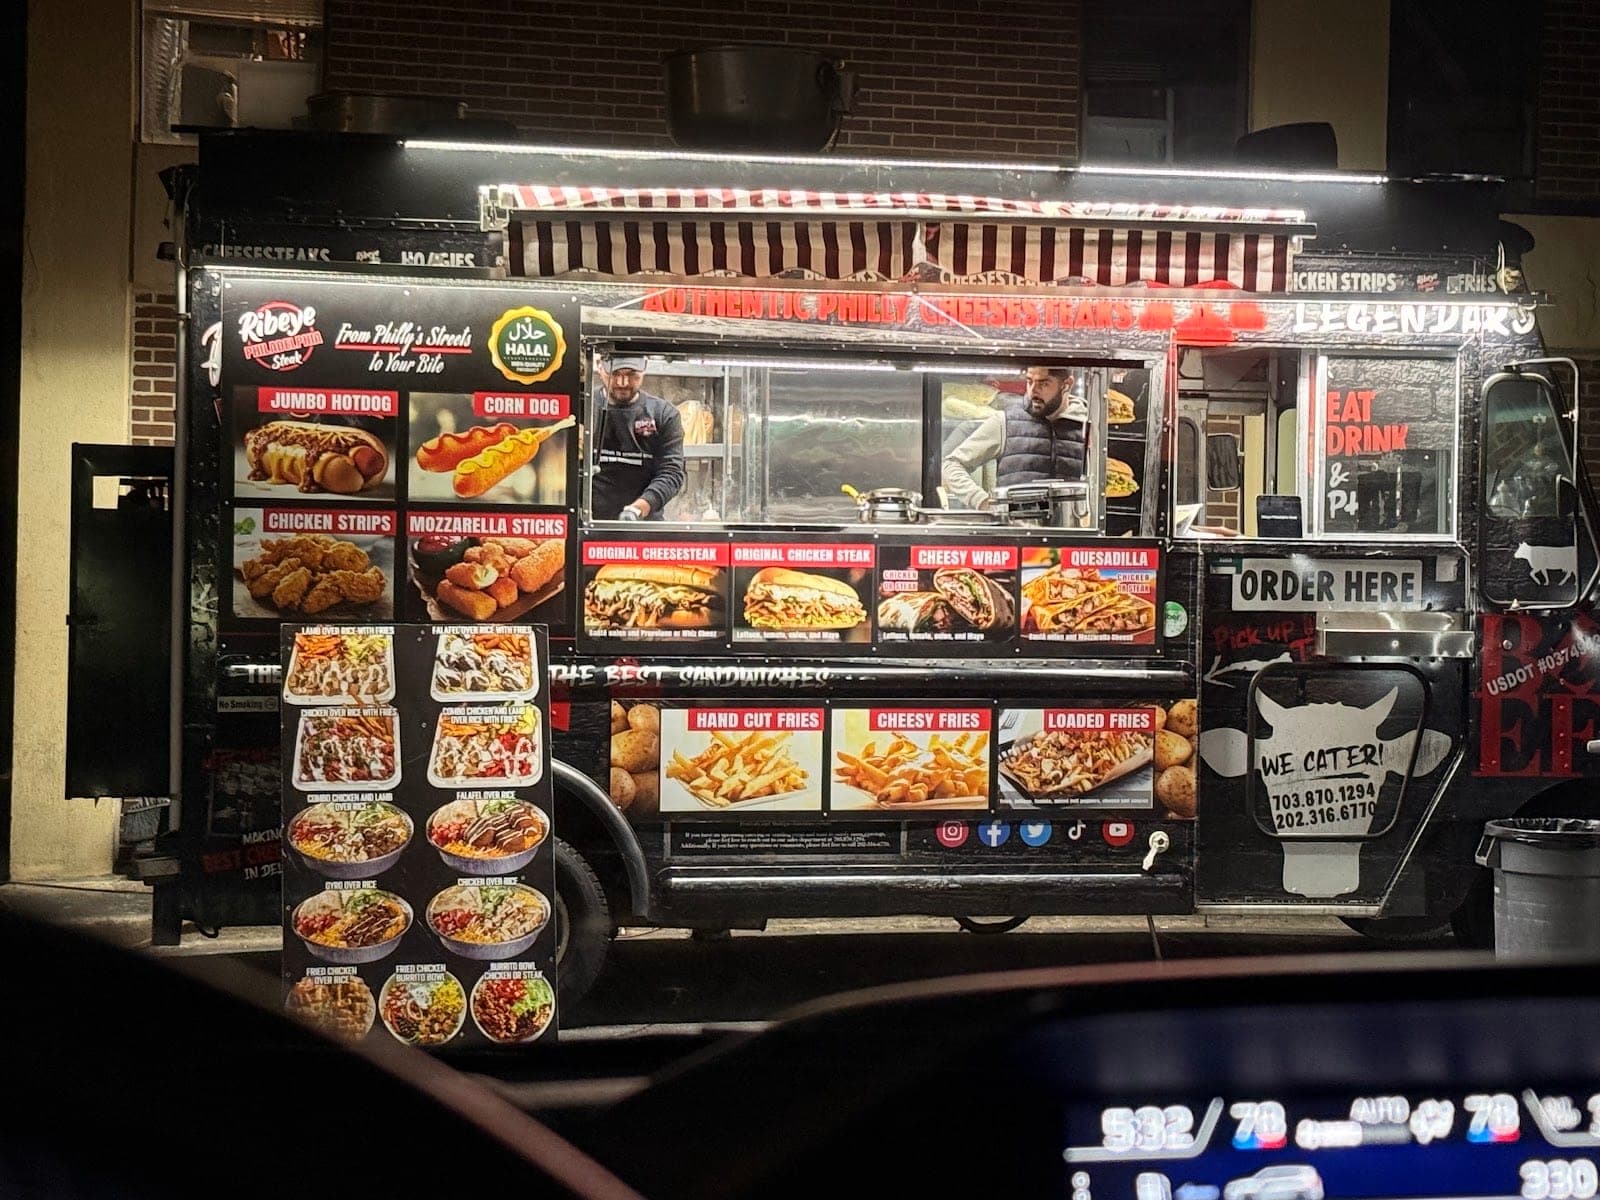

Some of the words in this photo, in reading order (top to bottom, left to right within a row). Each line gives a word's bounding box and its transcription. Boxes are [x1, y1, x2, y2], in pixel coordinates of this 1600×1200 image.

[1341, 271, 1397, 292] STRIPS
[643, 288, 811, 321] AUTHENTIC
[818, 294, 911, 325] PHILLY
[919, 296, 1134, 331] CHEESESTEAKS
[238, 306, 316, 343] Ribeye
[244, 332, 323, 359] PHILADELPHIA
[336, 323, 371, 345] From
[372, 321, 423, 356] Philly's
[425, 325, 472, 347] Streets
[505, 343, 551, 356] HALAL
[271, 351, 303, 370] Steak
[368, 351, 383, 372] to
[385, 352, 413, 373] Your
[415, 353, 444, 374] Bite
[270, 392, 327, 410] JUMBO
[331, 393, 392, 412] HOTDOG
[484, 397, 525, 415] CORN
[529, 398, 560, 416] DOG
[1327, 391, 1376, 423] EAT
[1326, 423, 1409, 457] DRINK
[1329, 462, 1350, 488] &
[268, 512, 333, 530] CHICKEN
[338, 514, 391, 531] STRIPS
[409, 516, 508, 533] MOZZARELLA
[512, 518, 564, 535] STICKS
[588, 546, 640, 561] ORIGINAL
[642, 547, 717, 562] CHEESESTEAK
[734, 547, 784, 562] ORIGINAL
[787, 548, 834, 562] CHICKEN
[837, 549, 871, 563] STEAK
[918, 550, 969, 565] CHEESY
[972, 551, 1011, 566] WRAP
[1071, 551, 1148, 567] QUESADILLA
[1240, 569, 1335, 601] ORDER
[1344, 570, 1416, 603] HERE
[548, 664, 597, 687] THE
[603, 664, 665, 687] BEST
[679, 665, 831, 688] SANDWICHES
[1487, 663, 1536, 697] USDOT
[696, 712, 738, 728] HAND
[743, 713, 774, 728] CUT
[777, 713, 820, 728] FRIES
[877, 712, 934, 728] CHEESY
[938, 713, 981, 728] FRIES
[1048, 713, 1105, 729] LOADED
[1109, 713, 1150, 729] FRIES
[1261, 752, 1295, 777] WE
[1303, 743, 1384, 772] CATER!
[1272, 782, 1376, 811] 703.870.1294
[1276, 801, 1376, 830] 202.316.6770
[344, 880, 361, 889] OVER
[362, 880, 378, 889] RICE
[457, 878, 485, 887] CHICKEN
[486, 878, 503, 886] OVER
[504, 877, 519, 886] RICE
[306, 967, 326, 976] FRIED
[327, 966, 357, 976] CHICKEN
[396, 965, 415, 973] FRIED
[416, 963, 446, 973] CHICKEN
[396, 973, 426, 982] BURRITO
[426, 973, 445, 982] BOWL
[484, 971, 512, 980] CHICKEN
[522, 970, 543, 979] STEAK
[314, 976, 333, 985] OVER
[333, 975, 350, 984] RICE
